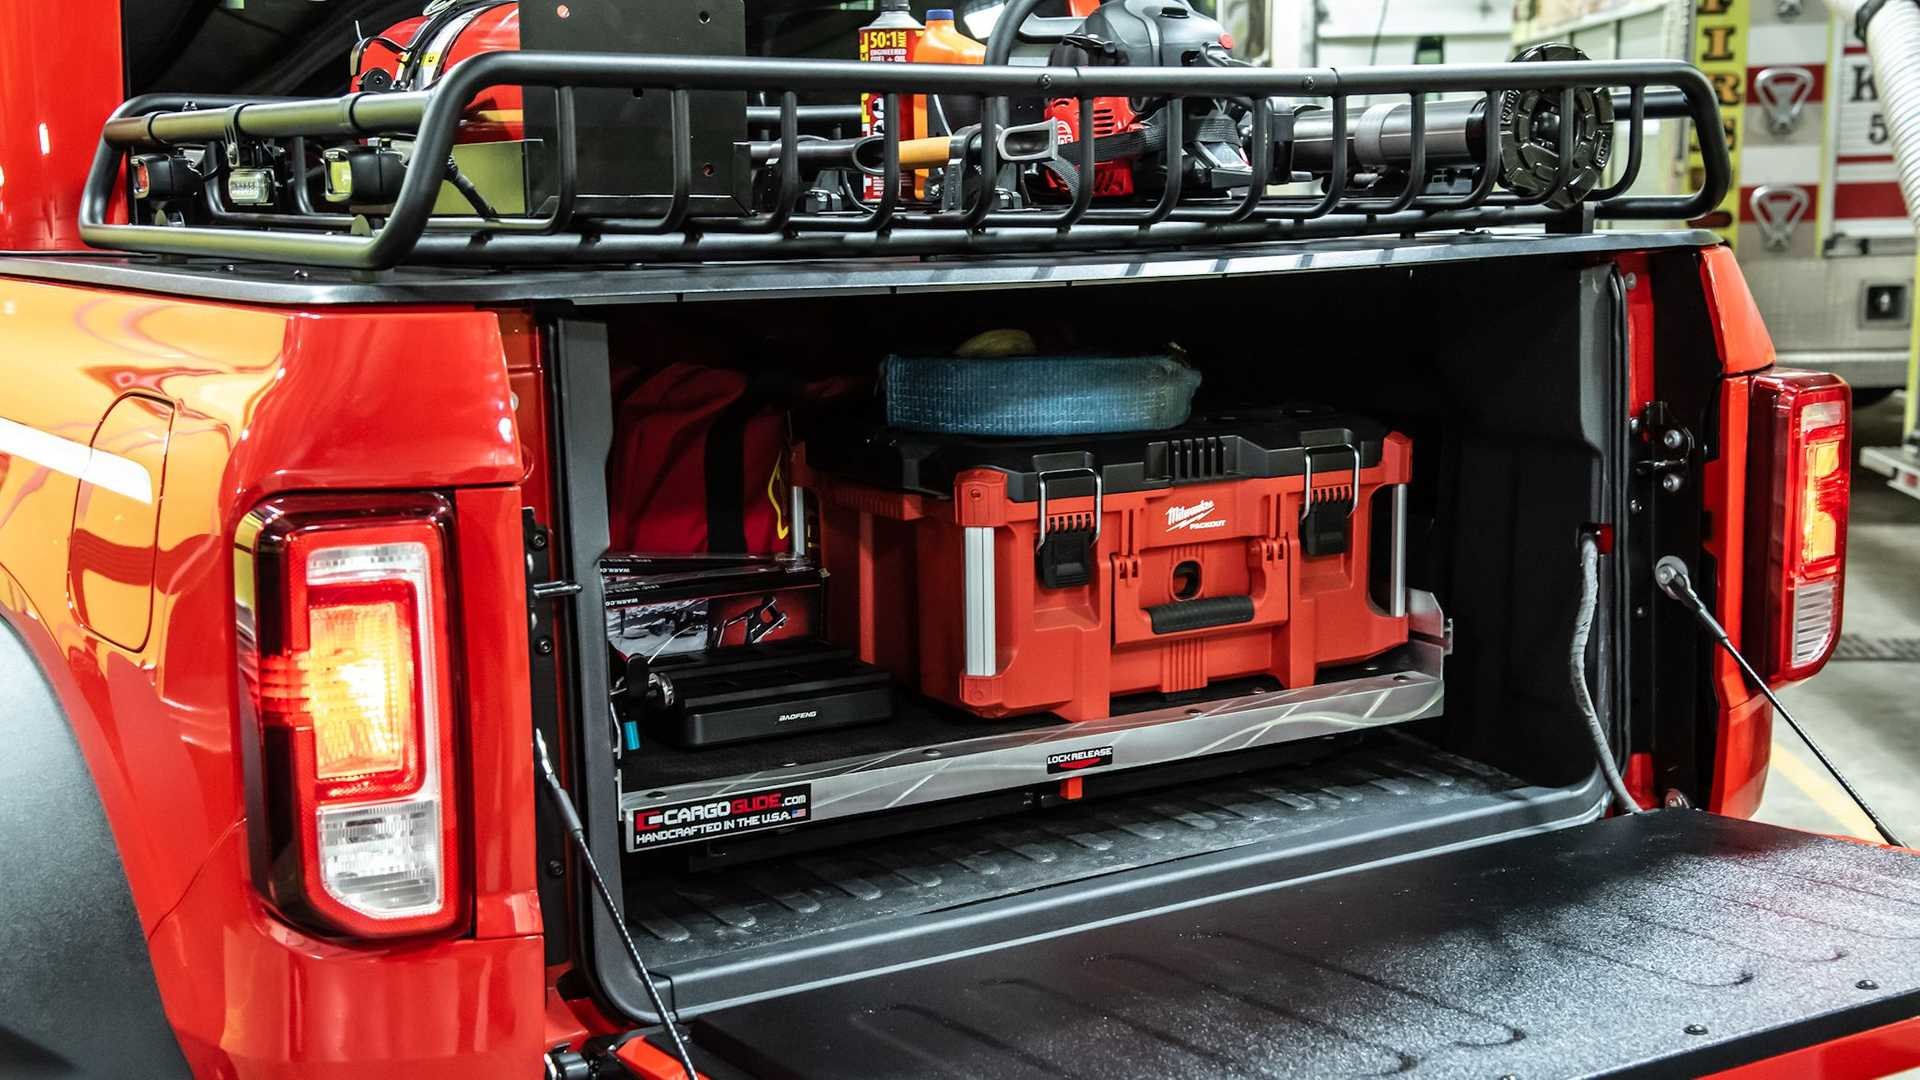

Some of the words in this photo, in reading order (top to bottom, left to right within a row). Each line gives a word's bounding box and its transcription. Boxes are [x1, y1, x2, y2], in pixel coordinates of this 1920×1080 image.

[870, 31, 897, 48] 50:1
[1165, 500, 1215, 526] Milwaukee
[1189, 520, 1227, 530] PACKOUT
[778, 711, 817, 721] BAOFENG
[1047, 754, 1071, 764] LOCK
[1071, 747, 1113, 760] RELEASE
[636, 821, 722, 844] HANDCRAFTED
[723, 820, 735, 830] IN
[736, 816, 760, 828] THE
[761, 811, 792, 823] U.S.A.
